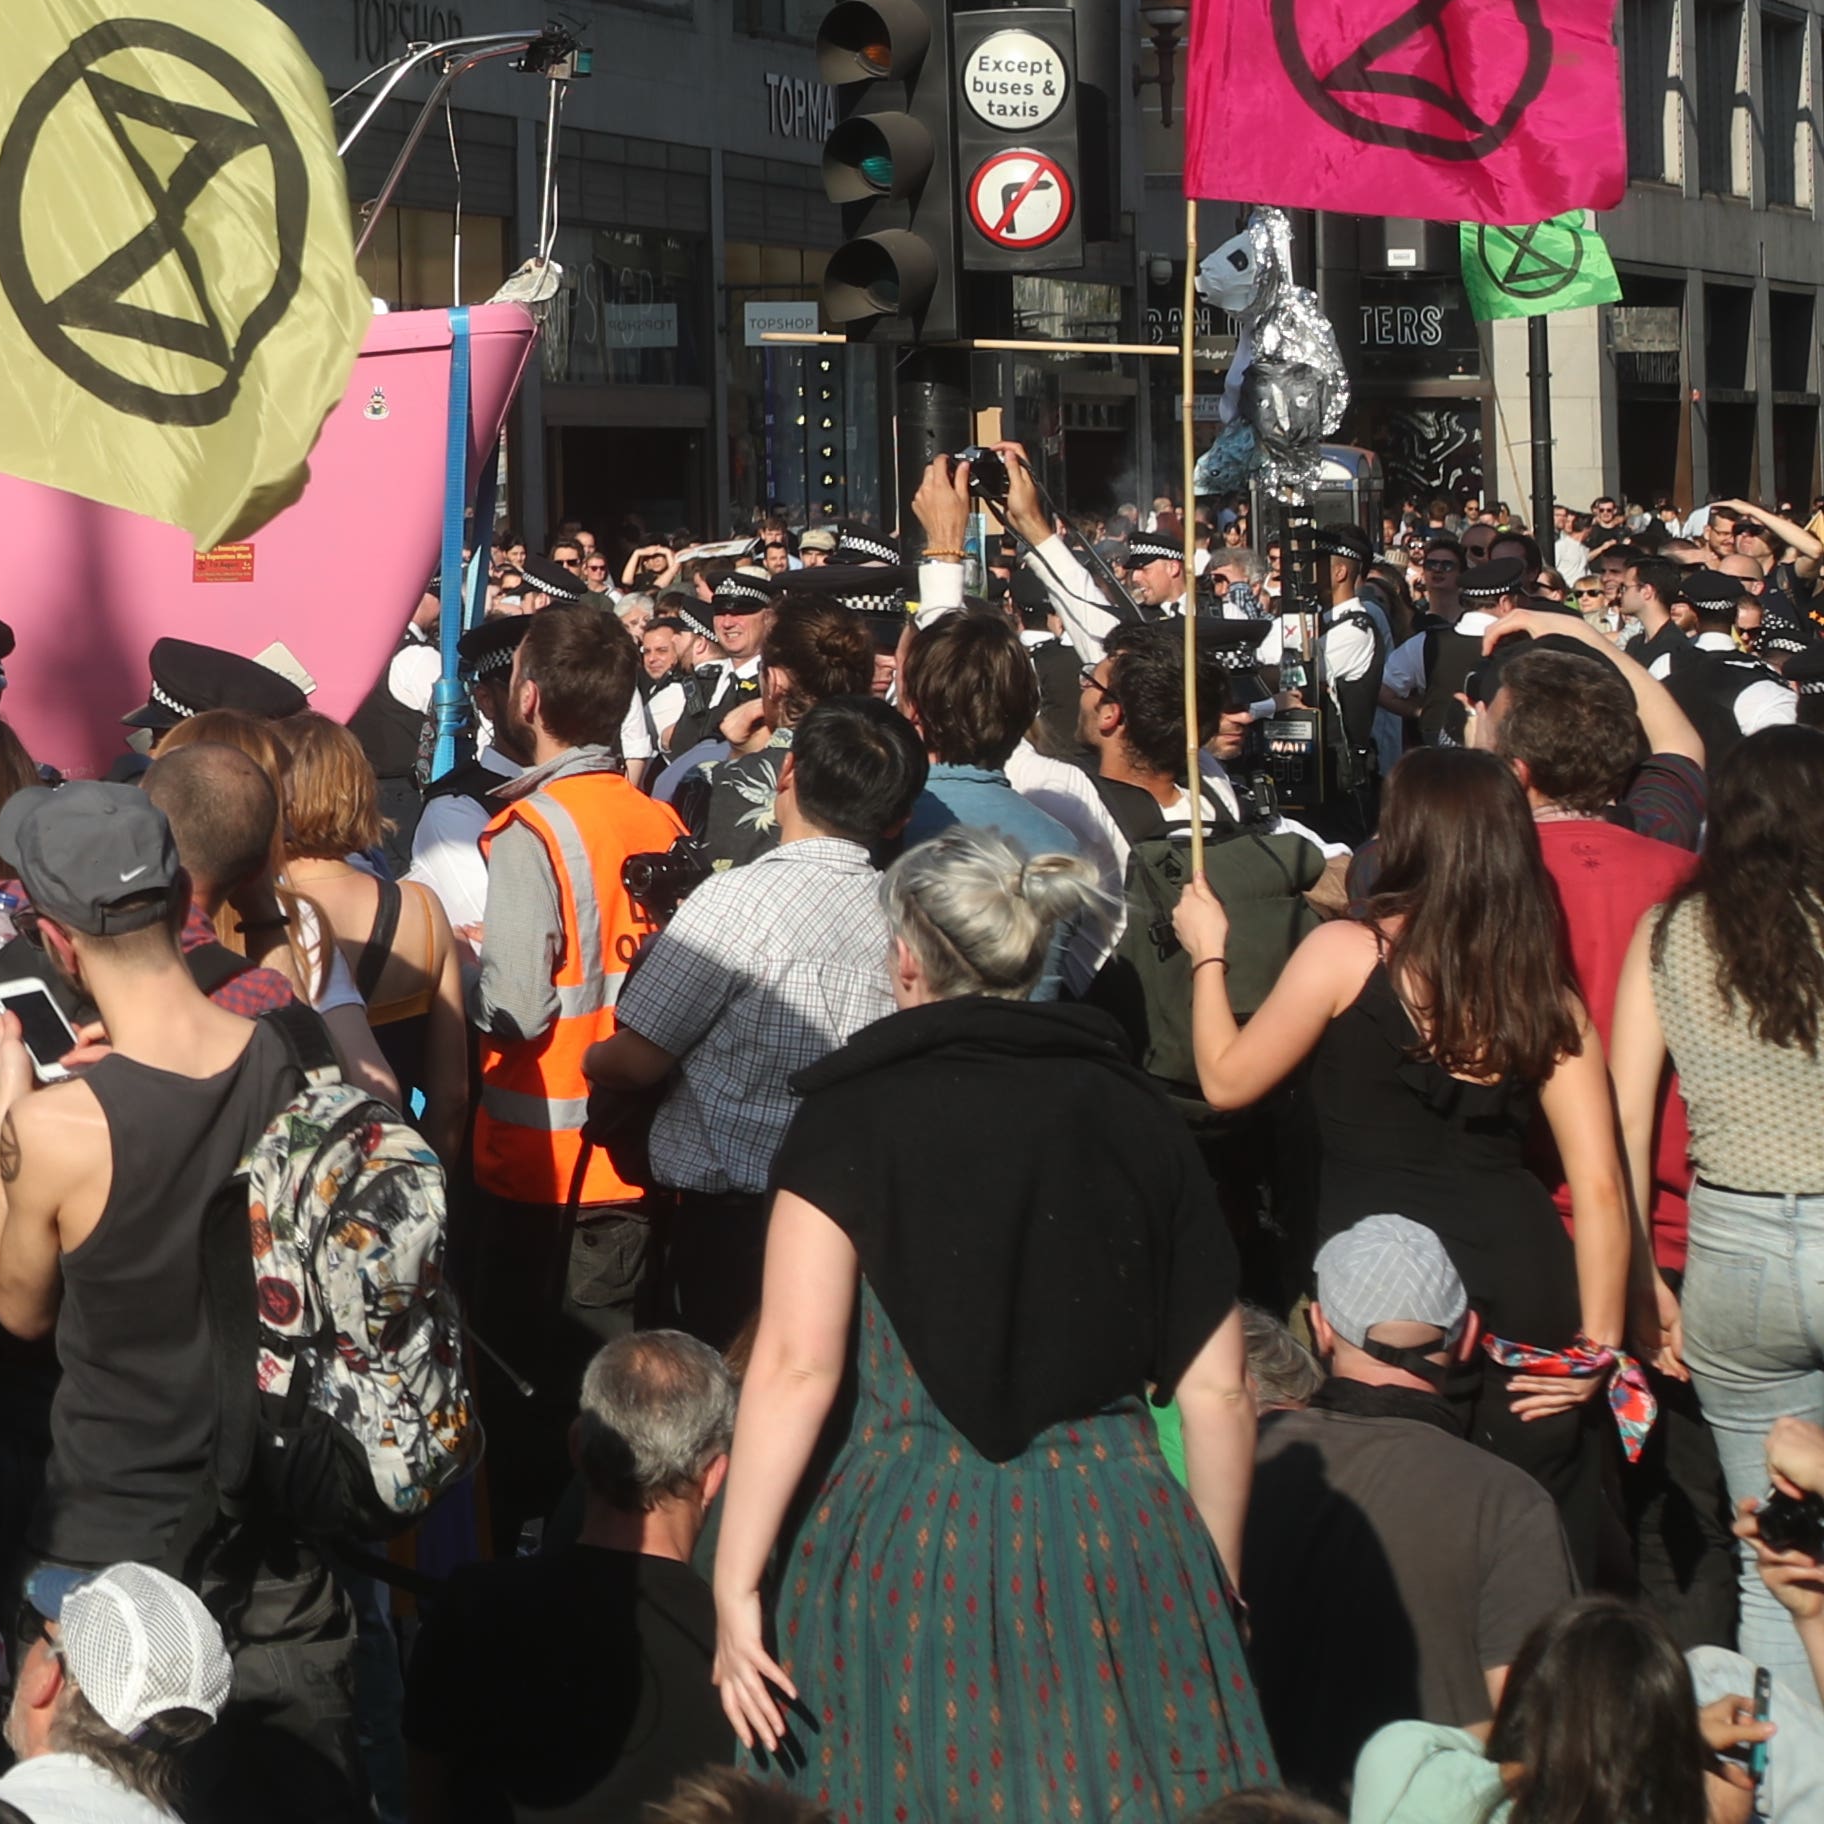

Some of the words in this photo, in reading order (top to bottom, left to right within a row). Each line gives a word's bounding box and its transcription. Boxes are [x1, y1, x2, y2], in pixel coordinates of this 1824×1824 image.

[978, 56, 1053, 75] Except
[973, 76, 1034, 96] buses
[1042, 79, 1057, 97] &
[764, 73, 837, 143] TOPMA
[987, 99, 1039, 118] taxis
[749, 318, 814, 329] TOPSHOP
